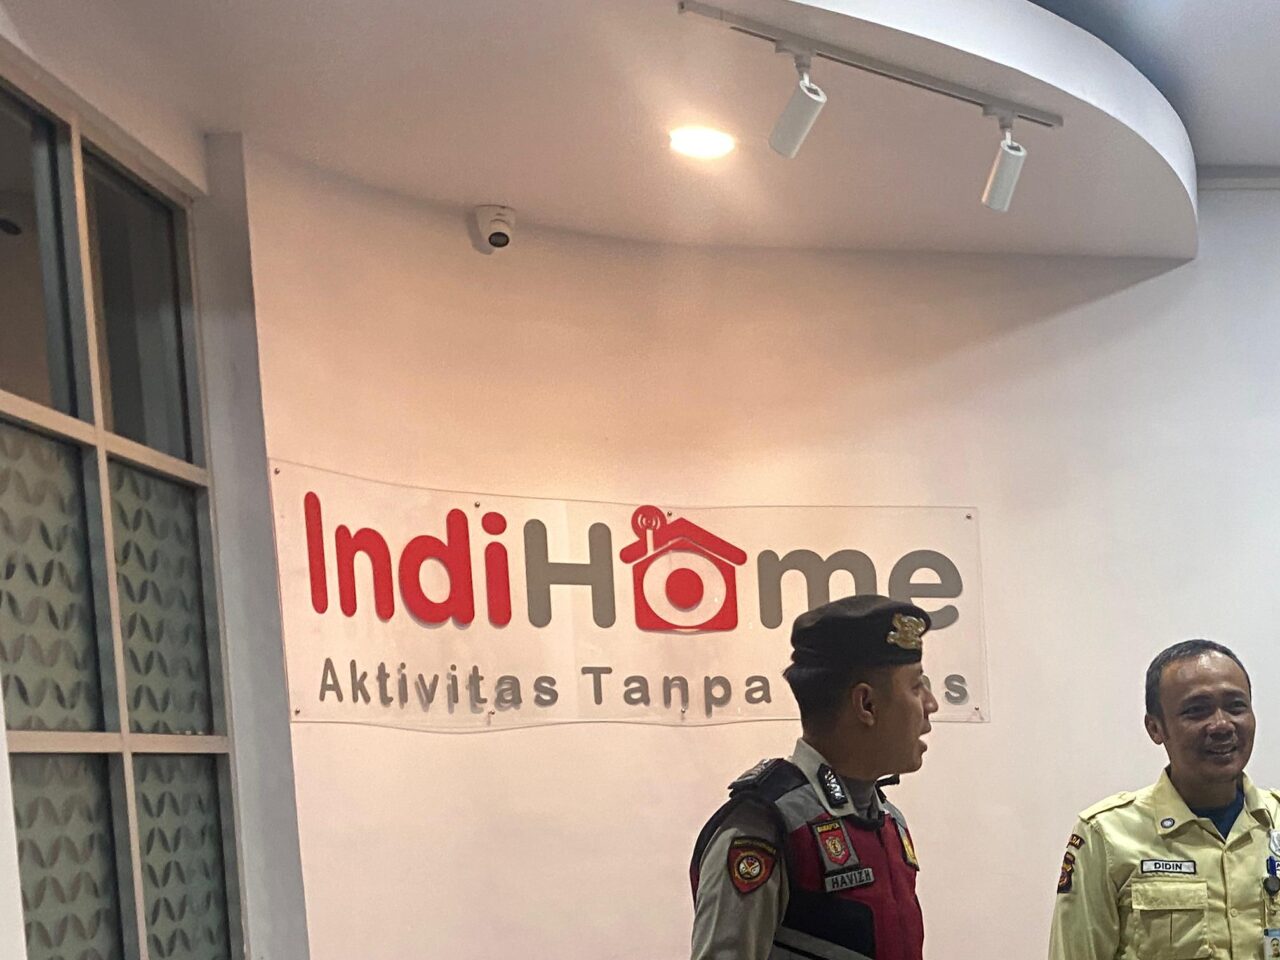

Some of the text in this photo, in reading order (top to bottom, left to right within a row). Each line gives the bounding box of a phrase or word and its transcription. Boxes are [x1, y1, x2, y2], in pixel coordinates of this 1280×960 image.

[303, 490, 964, 633] IndiHome
[319, 657, 773, 717] Aktivitas Tanpa
[831, 870, 872, 889] HAVIZH
[1153, 861, 1183, 872] DIDIN
